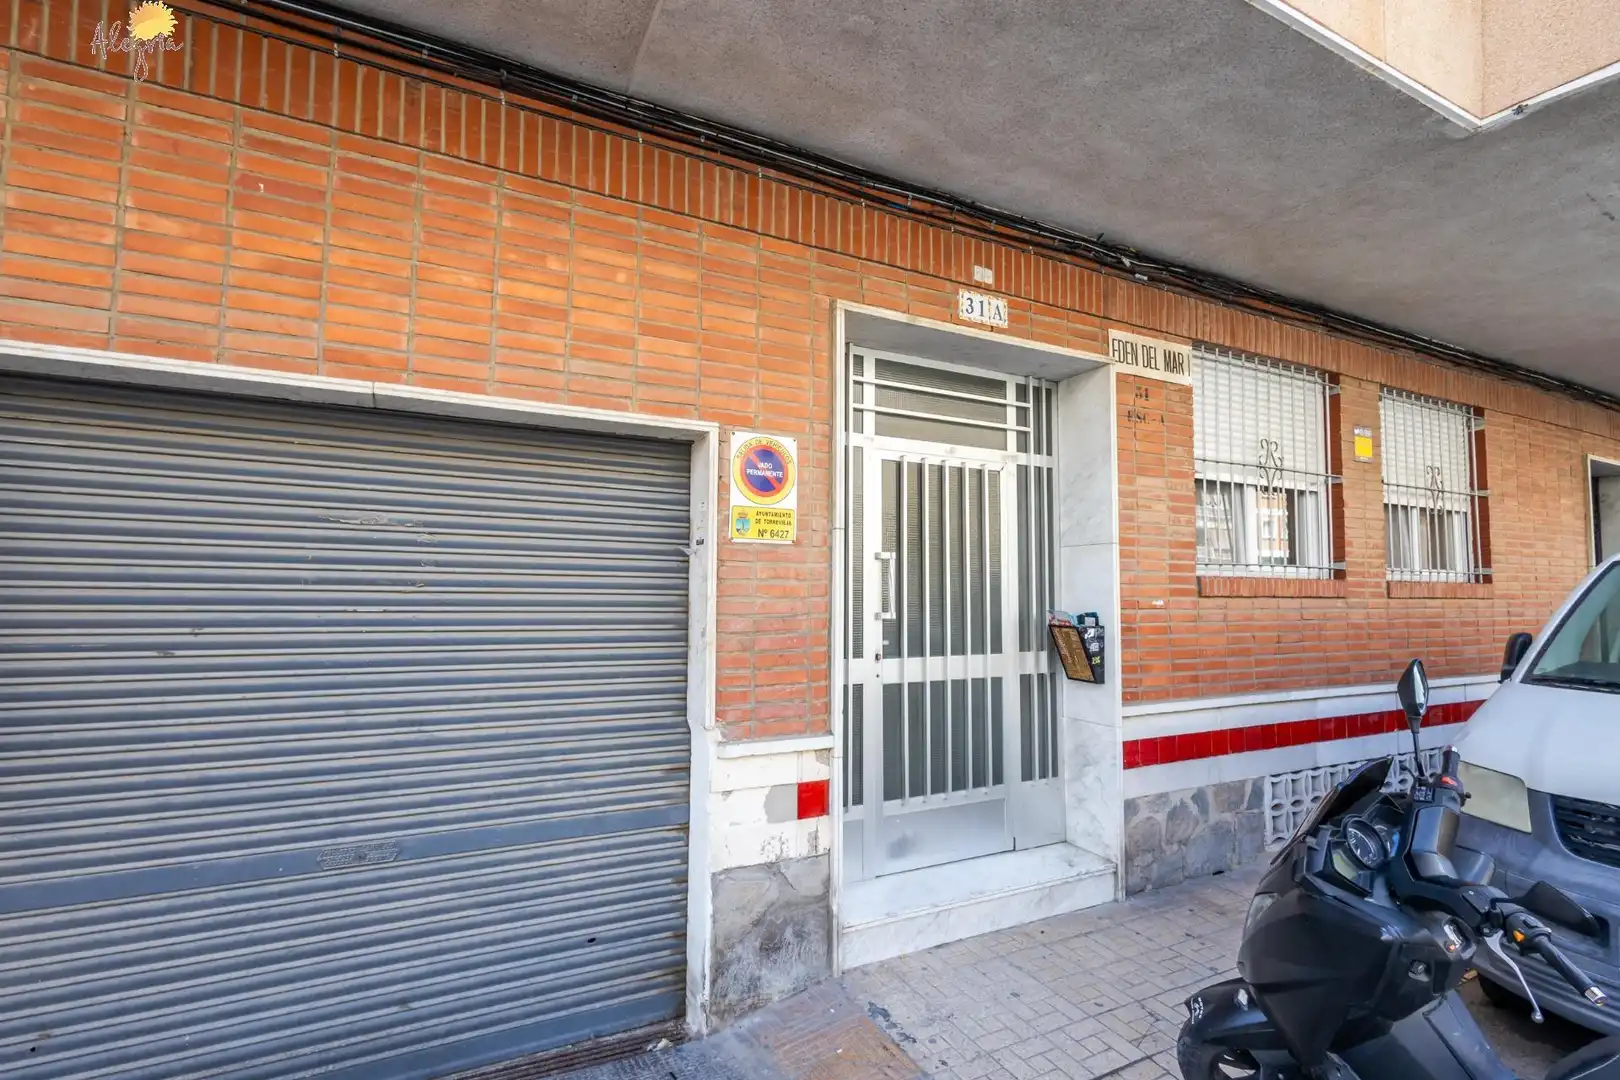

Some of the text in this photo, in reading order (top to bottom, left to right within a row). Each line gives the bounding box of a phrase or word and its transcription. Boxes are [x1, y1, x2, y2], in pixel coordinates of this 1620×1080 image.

[965, 297, 1004, 322] 31 A
[1112, 338, 1139, 367] EDEN
[1141, 344, 1161, 371] DEL
[1163, 348, 1185, 376] MAR
[746, 468, 784, 478] PERMANENTE
[755, 510, 792, 519] AYUNTAMIENTO
[764, 518, 792, 526] TORREVIEJA
[770, 529, 790, 539] 6427
